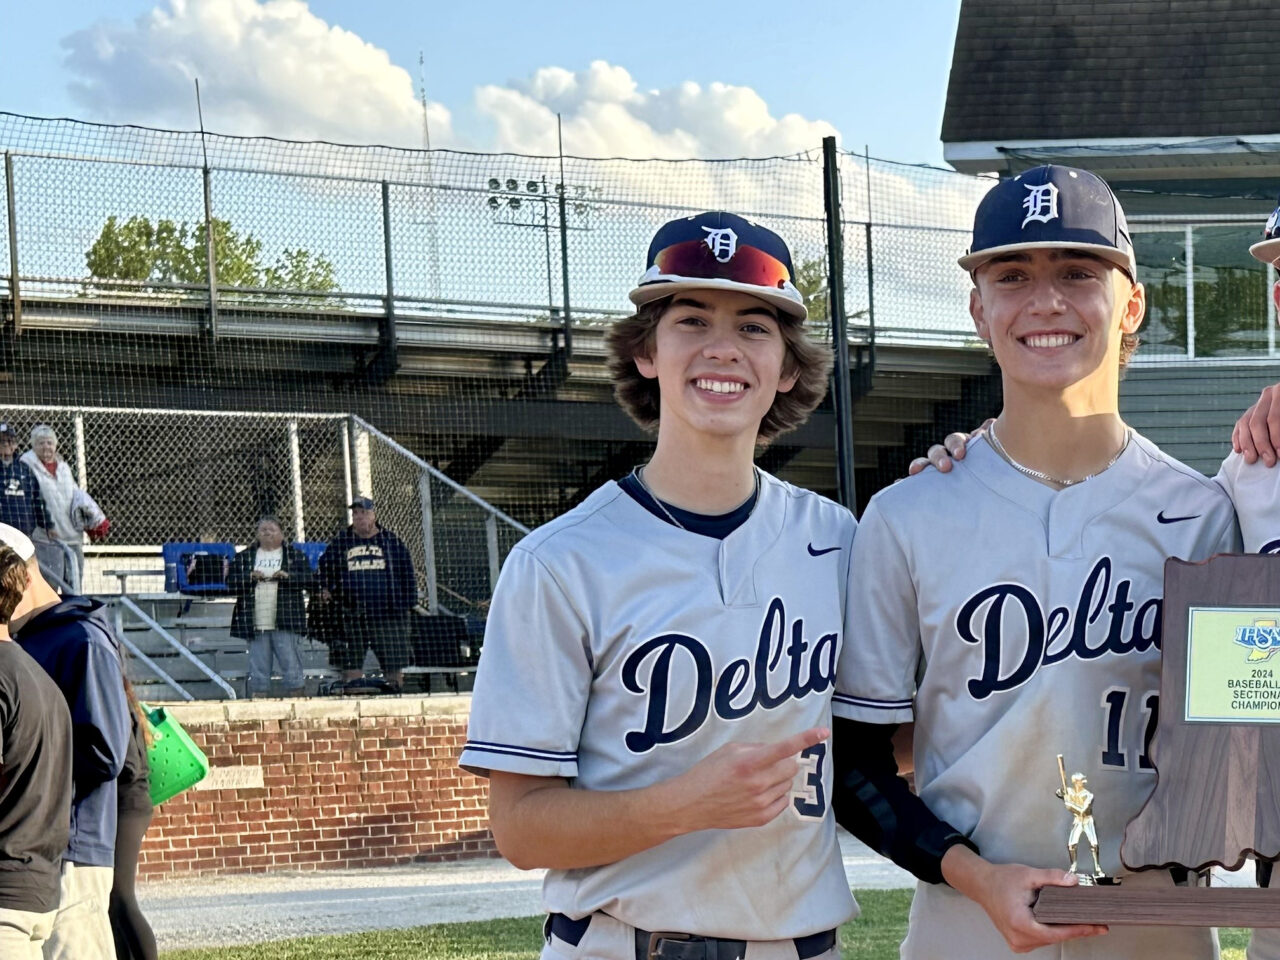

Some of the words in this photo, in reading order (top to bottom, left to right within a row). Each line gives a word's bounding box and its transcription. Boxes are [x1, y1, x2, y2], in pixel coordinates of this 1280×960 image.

[1022, 182, 1059, 229] D
[956, 555, 1164, 700] Delta
[621, 597, 839, 754] Delta
[1227, 680, 1280, 690] BASEBALL
[1251, 669, 1273, 679] 2024
